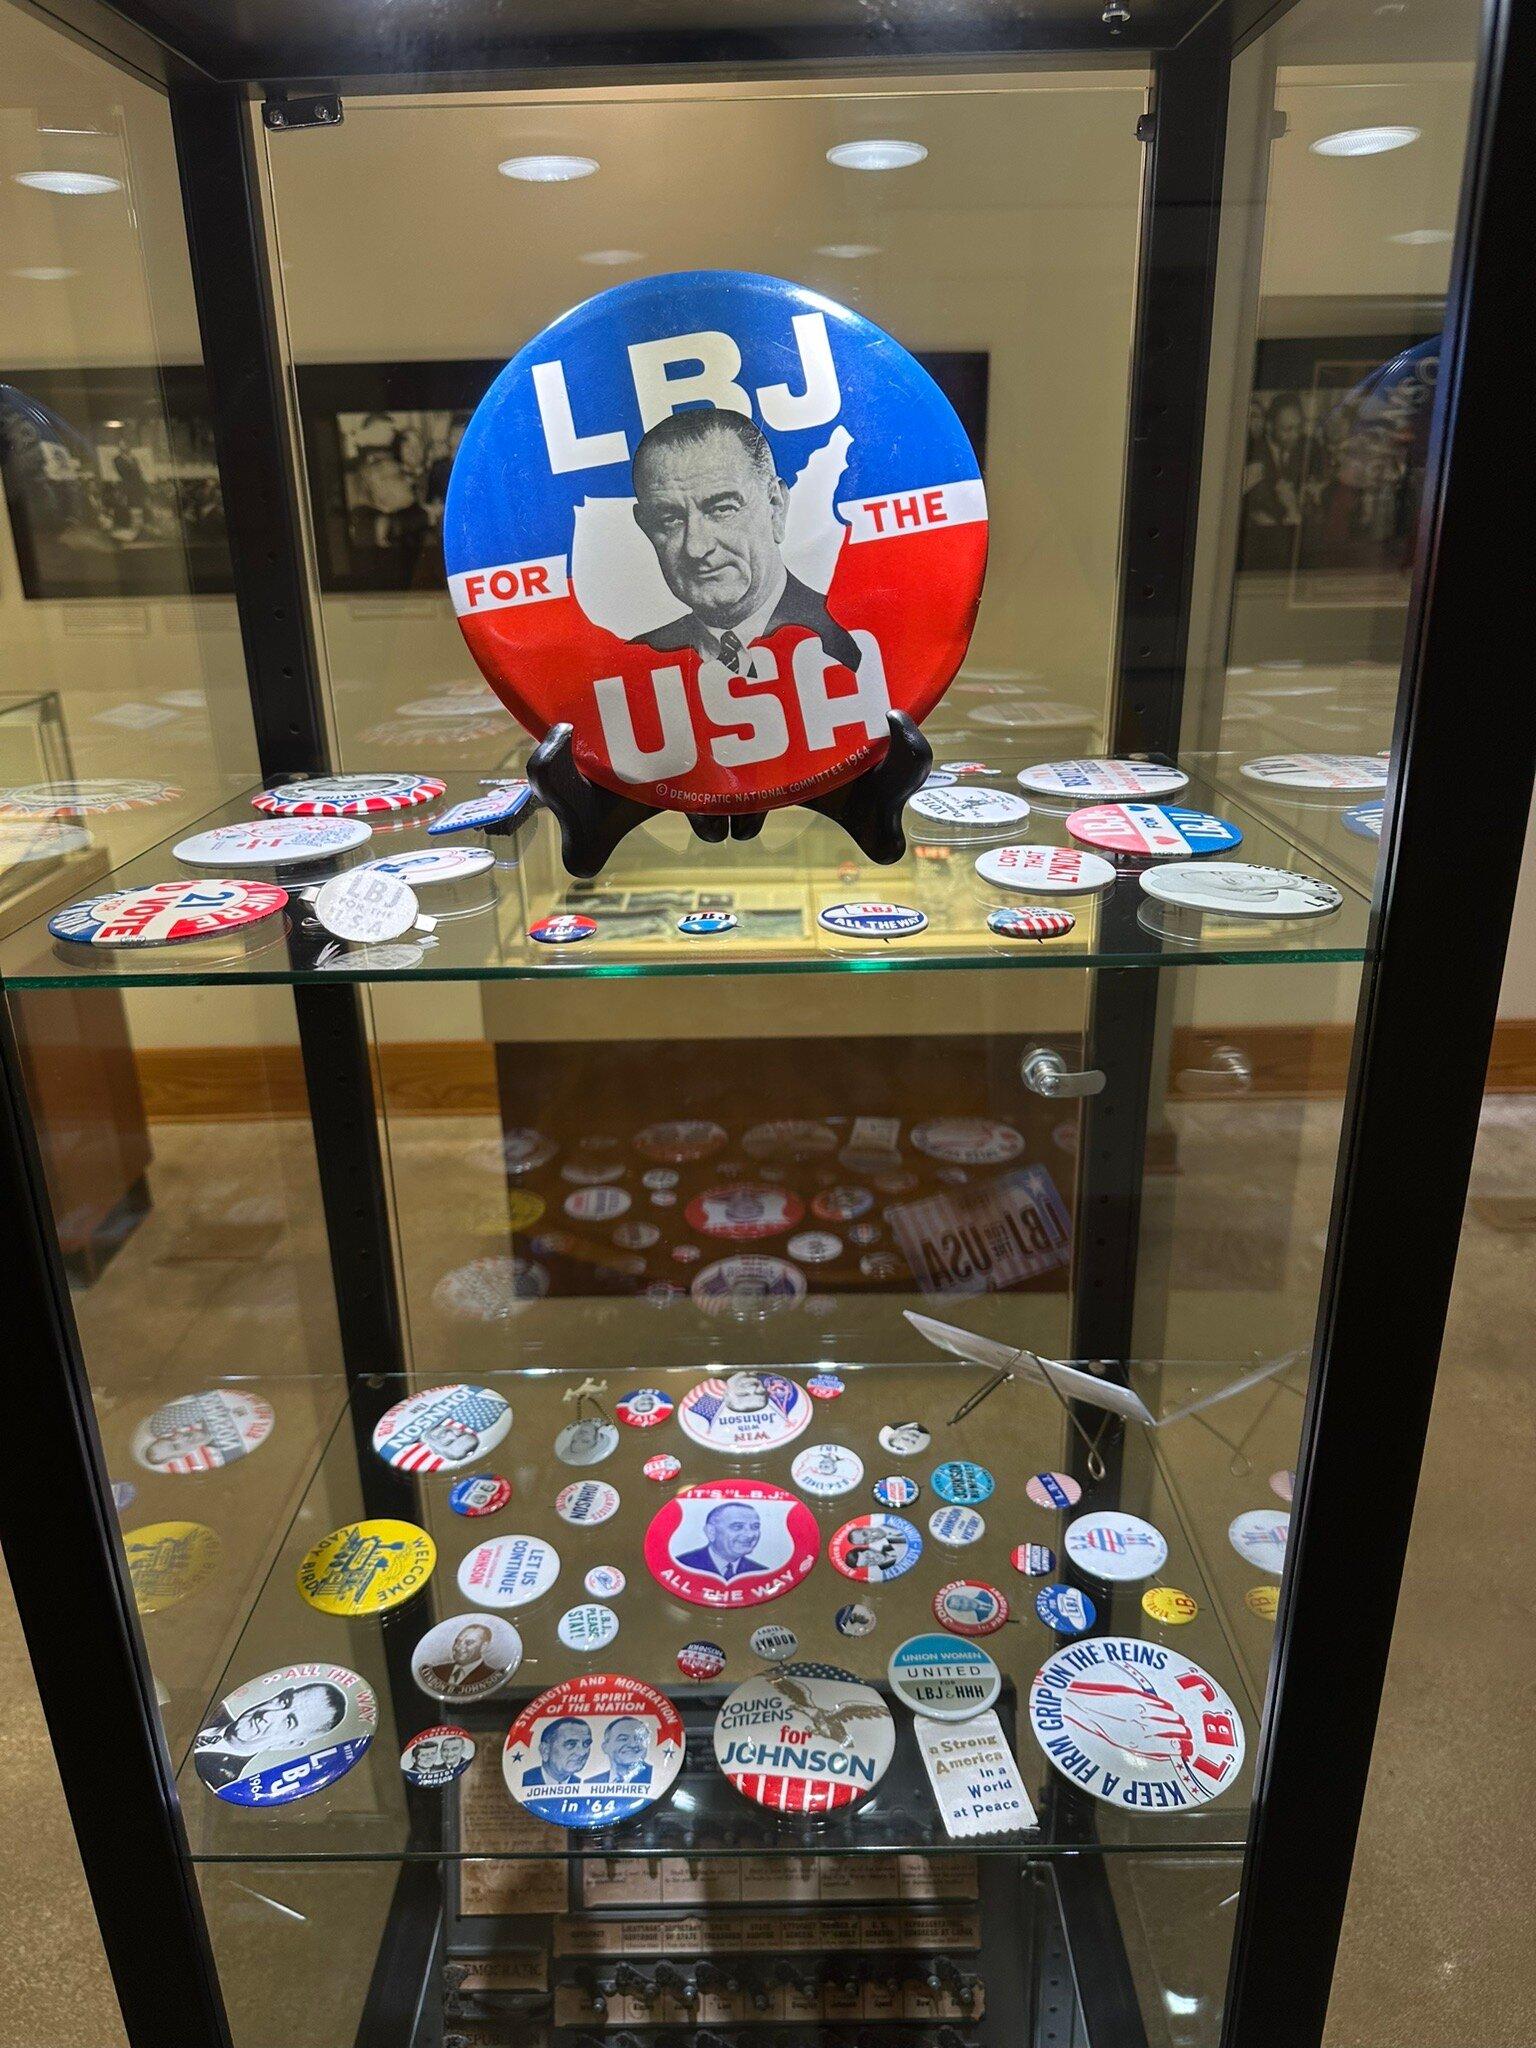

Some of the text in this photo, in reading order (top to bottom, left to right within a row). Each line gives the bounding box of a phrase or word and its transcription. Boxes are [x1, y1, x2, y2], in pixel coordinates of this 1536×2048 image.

[532, 312, 842, 475] LBJ
[863, 491, 948, 533] THE
[465, 565, 553, 607] FOR
[594, 629, 891, 785] USA
[669, 788, 732, 804] DEMOCRATIC
[735, 784, 788, 803] NATIONAL
[789, 763, 844, 790] COMMITTEE
[844, 746, 871, 774] 1964
[917, 797, 947, 815] VOTE
[1146, 816, 1160, 829] FOR
[998, 849, 1021, 867] LOVE
[1025, 850, 1045, 868] THAT
[1047, 848, 1081, 884] LYNDON
[182, 891, 232, 909] 21
[349, 873, 405, 908] LBJ
[99, 896, 167, 938] VOTE
[197, 893, 280, 928] WERE
[548, 914, 578, 926] 4
[685, 913, 731, 924] LBJ
[862, 905, 894, 914] LBJ
[834, 916, 920, 930] ALL THE WAY
[394, 1386, 476, 1448] JOHNSON
[719, 1413, 777, 1426] Johnson
[734, 1431, 771, 1442] WIN
[569, 1482, 600, 1519] JOHNSON
[687, 1490, 722, 1499] IT'S
[833, 1521, 856, 1545] Needs
[884, 1515, 922, 1542] JOHNSON
[941, 1509, 960, 1539] JOHNSON
[301, 1529, 351, 1597] LADY BIRD
[377, 1536, 430, 1602] WELCOME
[469, 1548, 494, 1585] JOHNSON
[498, 1540, 528, 1594] CONTINUE
[521, 1549, 545, 1587] LET US
[834, 1545, 856, 1577] America
[884, 1550, 922, 1577] KENNEDY
[661, 1569, 795, 1601] ALL THE WAY
[938, 1581, 966, 1623] JOHNSON
[1069, 1597, 1080, 1620] LBJ
[568, 1611, 586, 1640] STAY!
[586, 1607, 600, 1638] PLEASE
[755, 1634, 797, 1651] LYNDON
[903, 1650, 982, 1663] UNION WOMEN
[1061, 1641, 1105, 1671] THE
[1103, 1643, 1167, 1670] REINS
[421, 1665, 447, 1692] LYNDON
[458, 1670, 503, 1695] JOHNSON
[907, 1666, 982, 1678] UNITED
[1043, 1662, 1075, 1689] ON
[285, 1664, 377, 1724] ALL THE WAY
[516, 1676, 678, 1728] STRENGTH AND MODERATION
[562, 1692, 633, 1703] THE SPIRIT
[916, 1687, 942, 1701] LBJ
[955, 1685, 985, 1699] HHH
[546, 1702, 646, 1714] OF THE NATION
[720, 1697, 783, 1717] YOUNG
[720, 1708, 794, 1730] CITIZENS
[1036, 1688, 1064, 1731] GRIP
[780, 1724, 813, 1746] for
[929, 1735, 998, 1756] a Strong
[720, 1741, 877, 1782] JOHNSON
[936, 1752, 1004, 1775] America
[1046, 1735, 1100, 1784] FIRM
[417, 1769, 454, 1780] KENNEDY
[418, 1775, 454, 1786] JOHNSON
[979, 1767, 1008, 1779] In a
[1101, 1772, 1120, 1796] A
[249, 1773, 262, 1801] 1964
[527, 1785, 651, 1797] JOHNSON HUMPHREY
[968, 1779, 1013, 1799] World
[1123, 1780, 1187, 1806] KEEP
[561, 1799, 616, 1813] in '64
[953, 1798, 1020, 1820] at Peace
